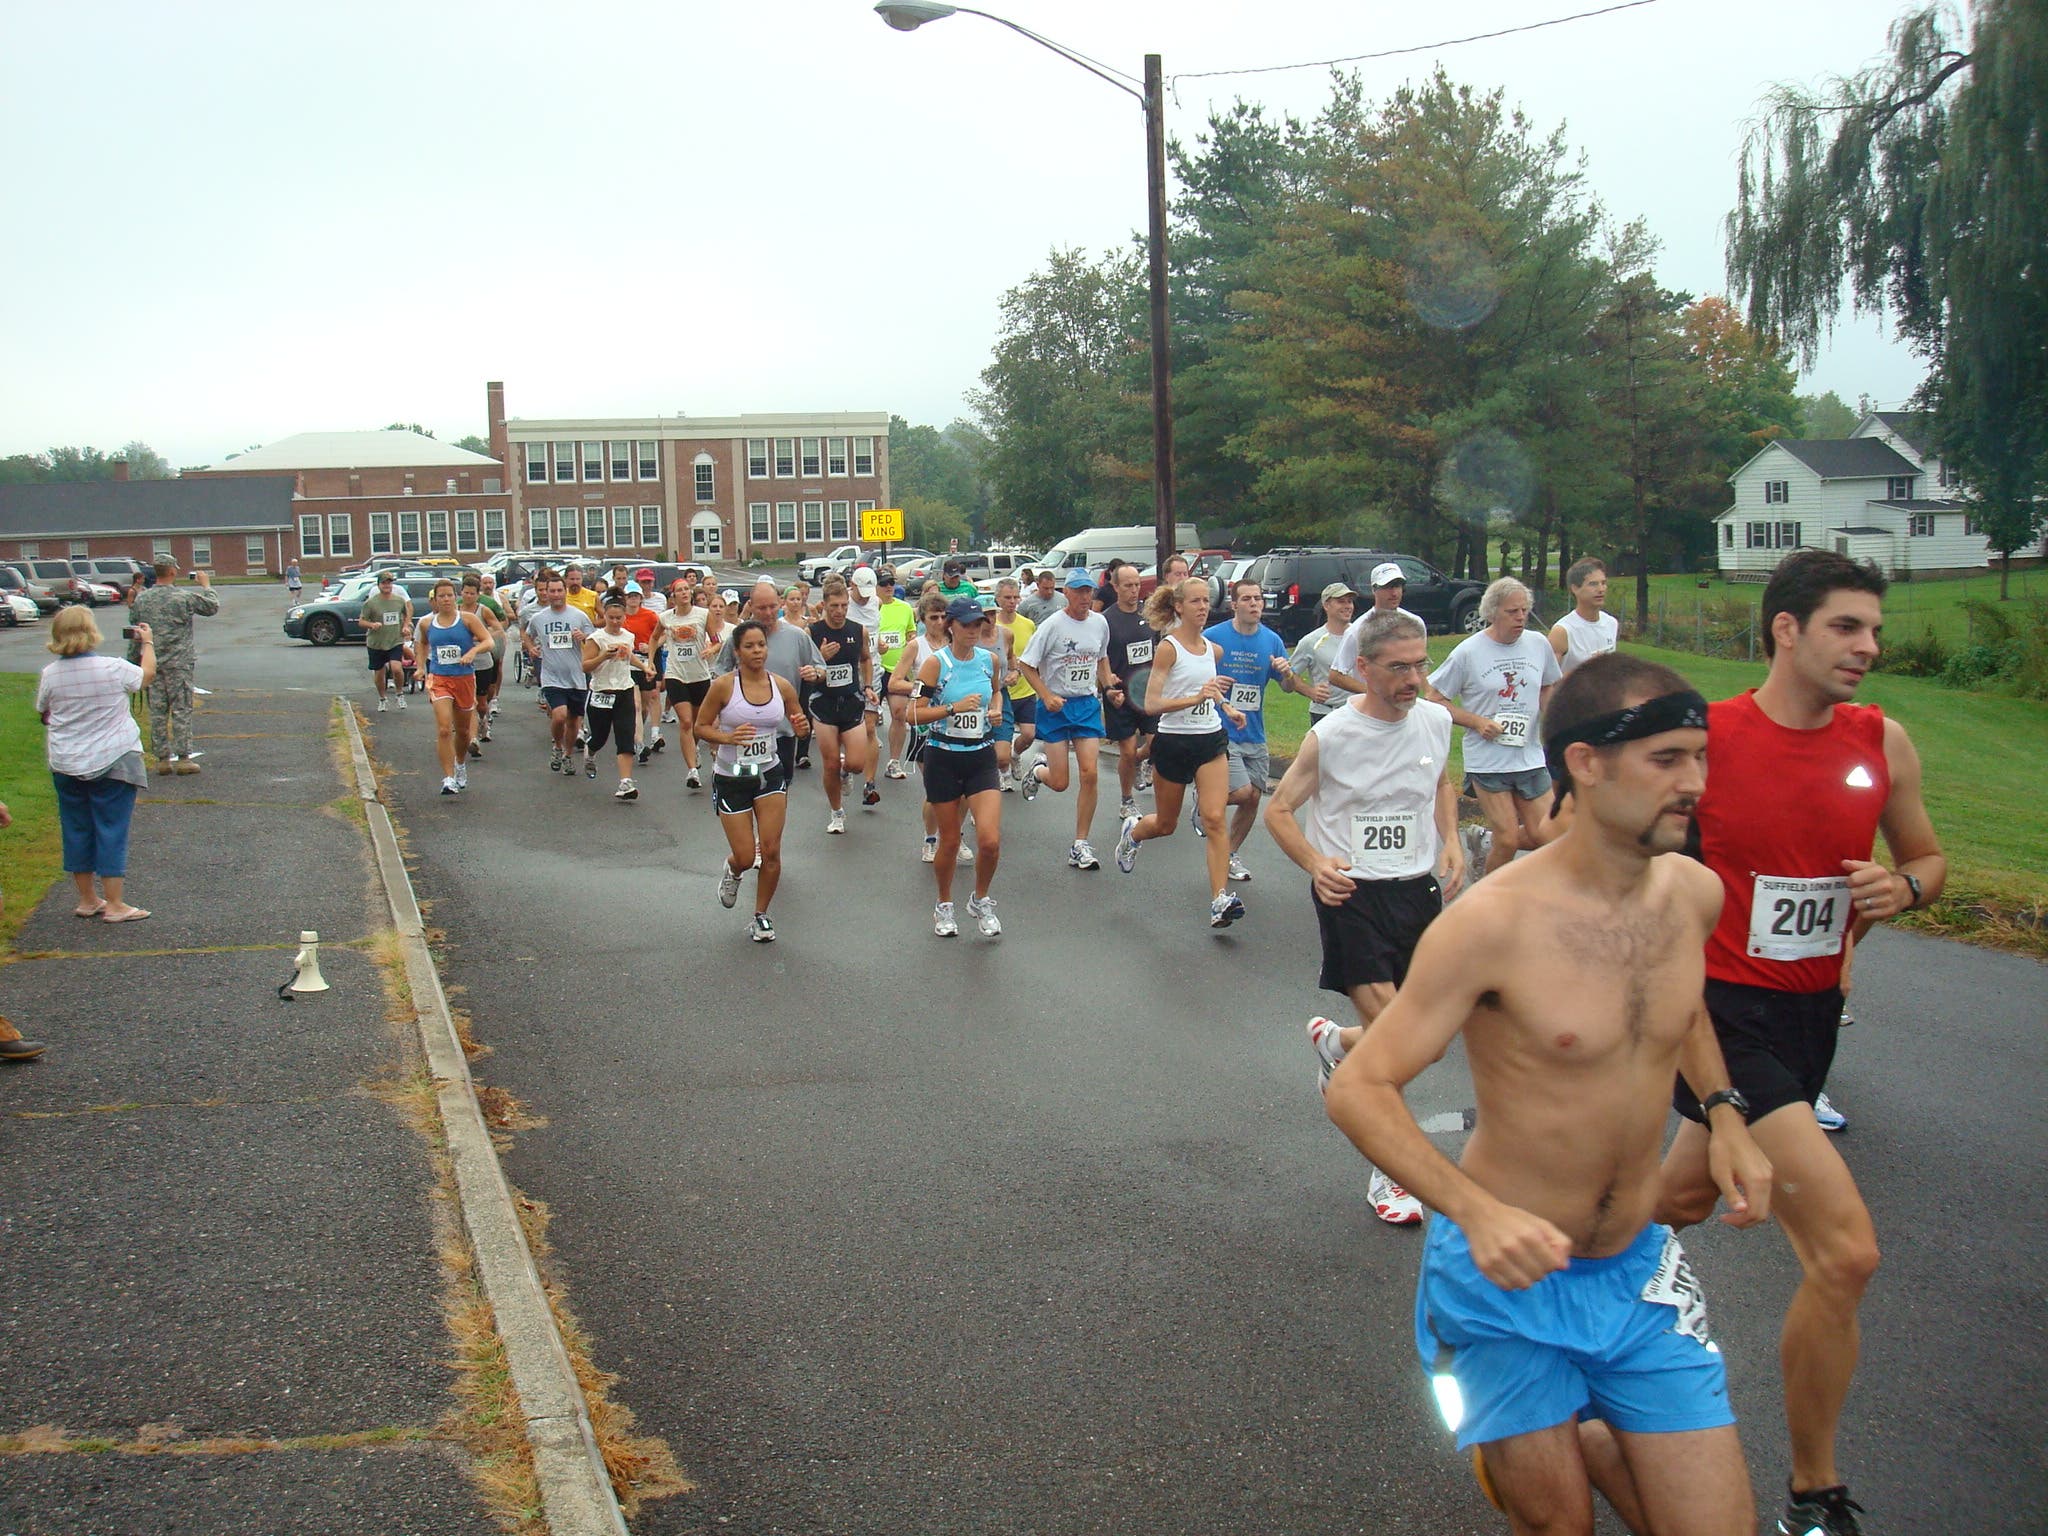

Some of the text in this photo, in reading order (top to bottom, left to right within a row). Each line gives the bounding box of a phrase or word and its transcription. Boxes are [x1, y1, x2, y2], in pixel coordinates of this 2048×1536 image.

[870, 514, 893, 525] PED
[870, 526, 896, 537] XING
[544, 621, 572, 635] USA
[552, 635, 568, 644] 279
[884, 635, 899, 644] 266
[440, 649, 458, 660] 248
[677, 647, 693, 657] 230
[1131, 645, 1149, 658] 220
[829, 669, 849, 681] 232
[1070, 668, 1090, 682] 275
[1236, 690, 1257, 704] 242
[1191, 702, 1210, 716] 281
[953, 714, 977, 729] 209
[1500, 720, 1526, 737] 262
[743, 741, 767, 757] 208
[1363, 825, 1406, 850] 269
[1762, 880, 1808, 892] SUFFIELD
[1770, 897, 1835, 936] 204
